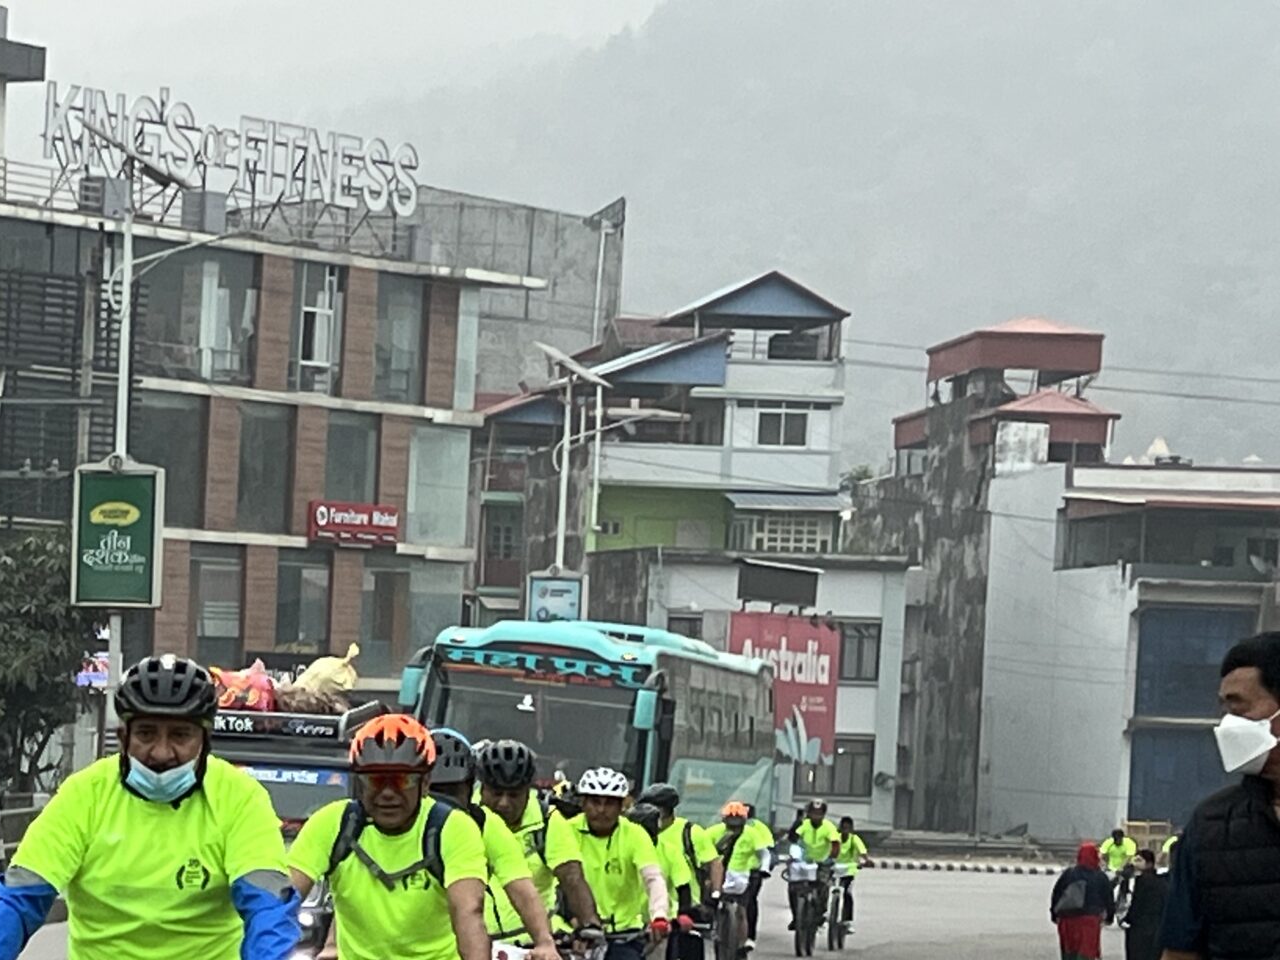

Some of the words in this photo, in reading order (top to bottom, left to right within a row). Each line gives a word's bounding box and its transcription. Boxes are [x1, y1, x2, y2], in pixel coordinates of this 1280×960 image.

[43, 80, 196, 182] KING'S
[200, 124, 239, 168] OF
[237, 115, 420, 217] FITNESS
